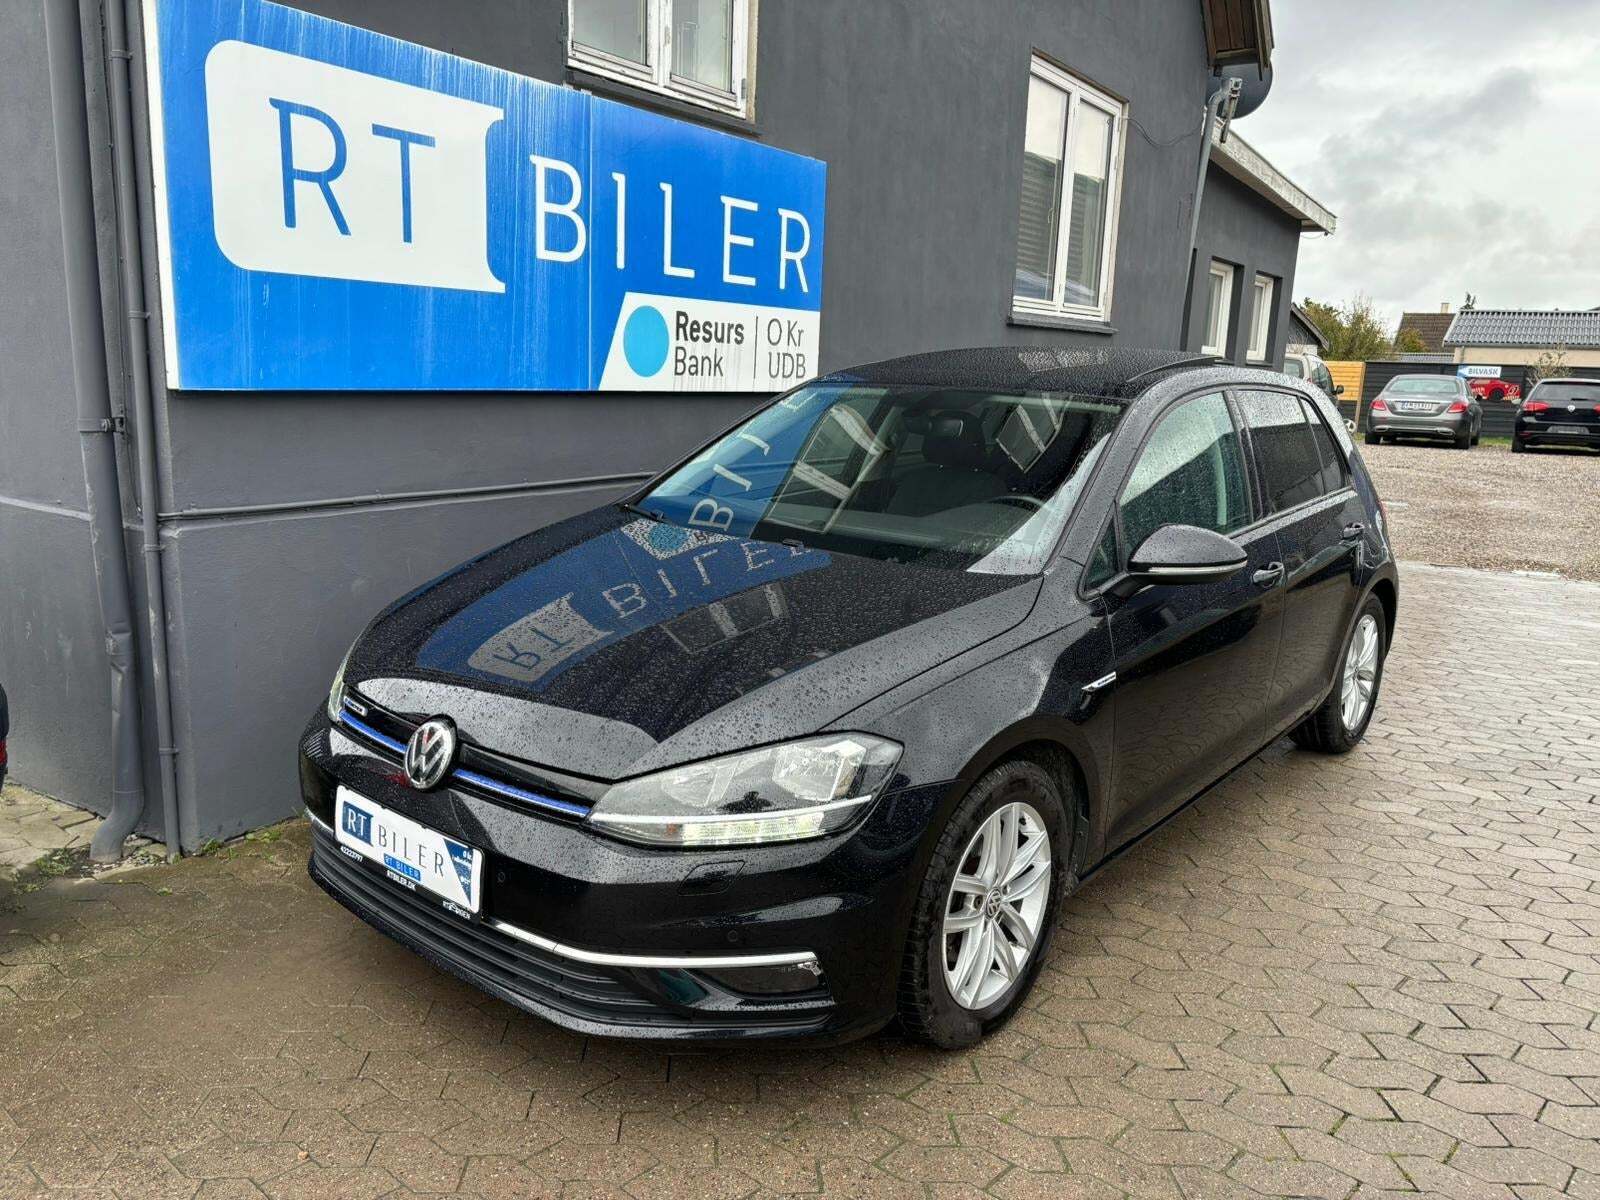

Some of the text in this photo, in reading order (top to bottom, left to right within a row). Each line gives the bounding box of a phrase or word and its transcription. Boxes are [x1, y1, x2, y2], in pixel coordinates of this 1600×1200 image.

[269, 97, 811, 293] RT BILER
[675, 310, 745, 345] Resurs
[787, 319, 804, 347] Kr
[674, 346, 724, 377] Bank
[768, 351, 806, 379] UDB
[347, 808, 444, 878] RT BILER
